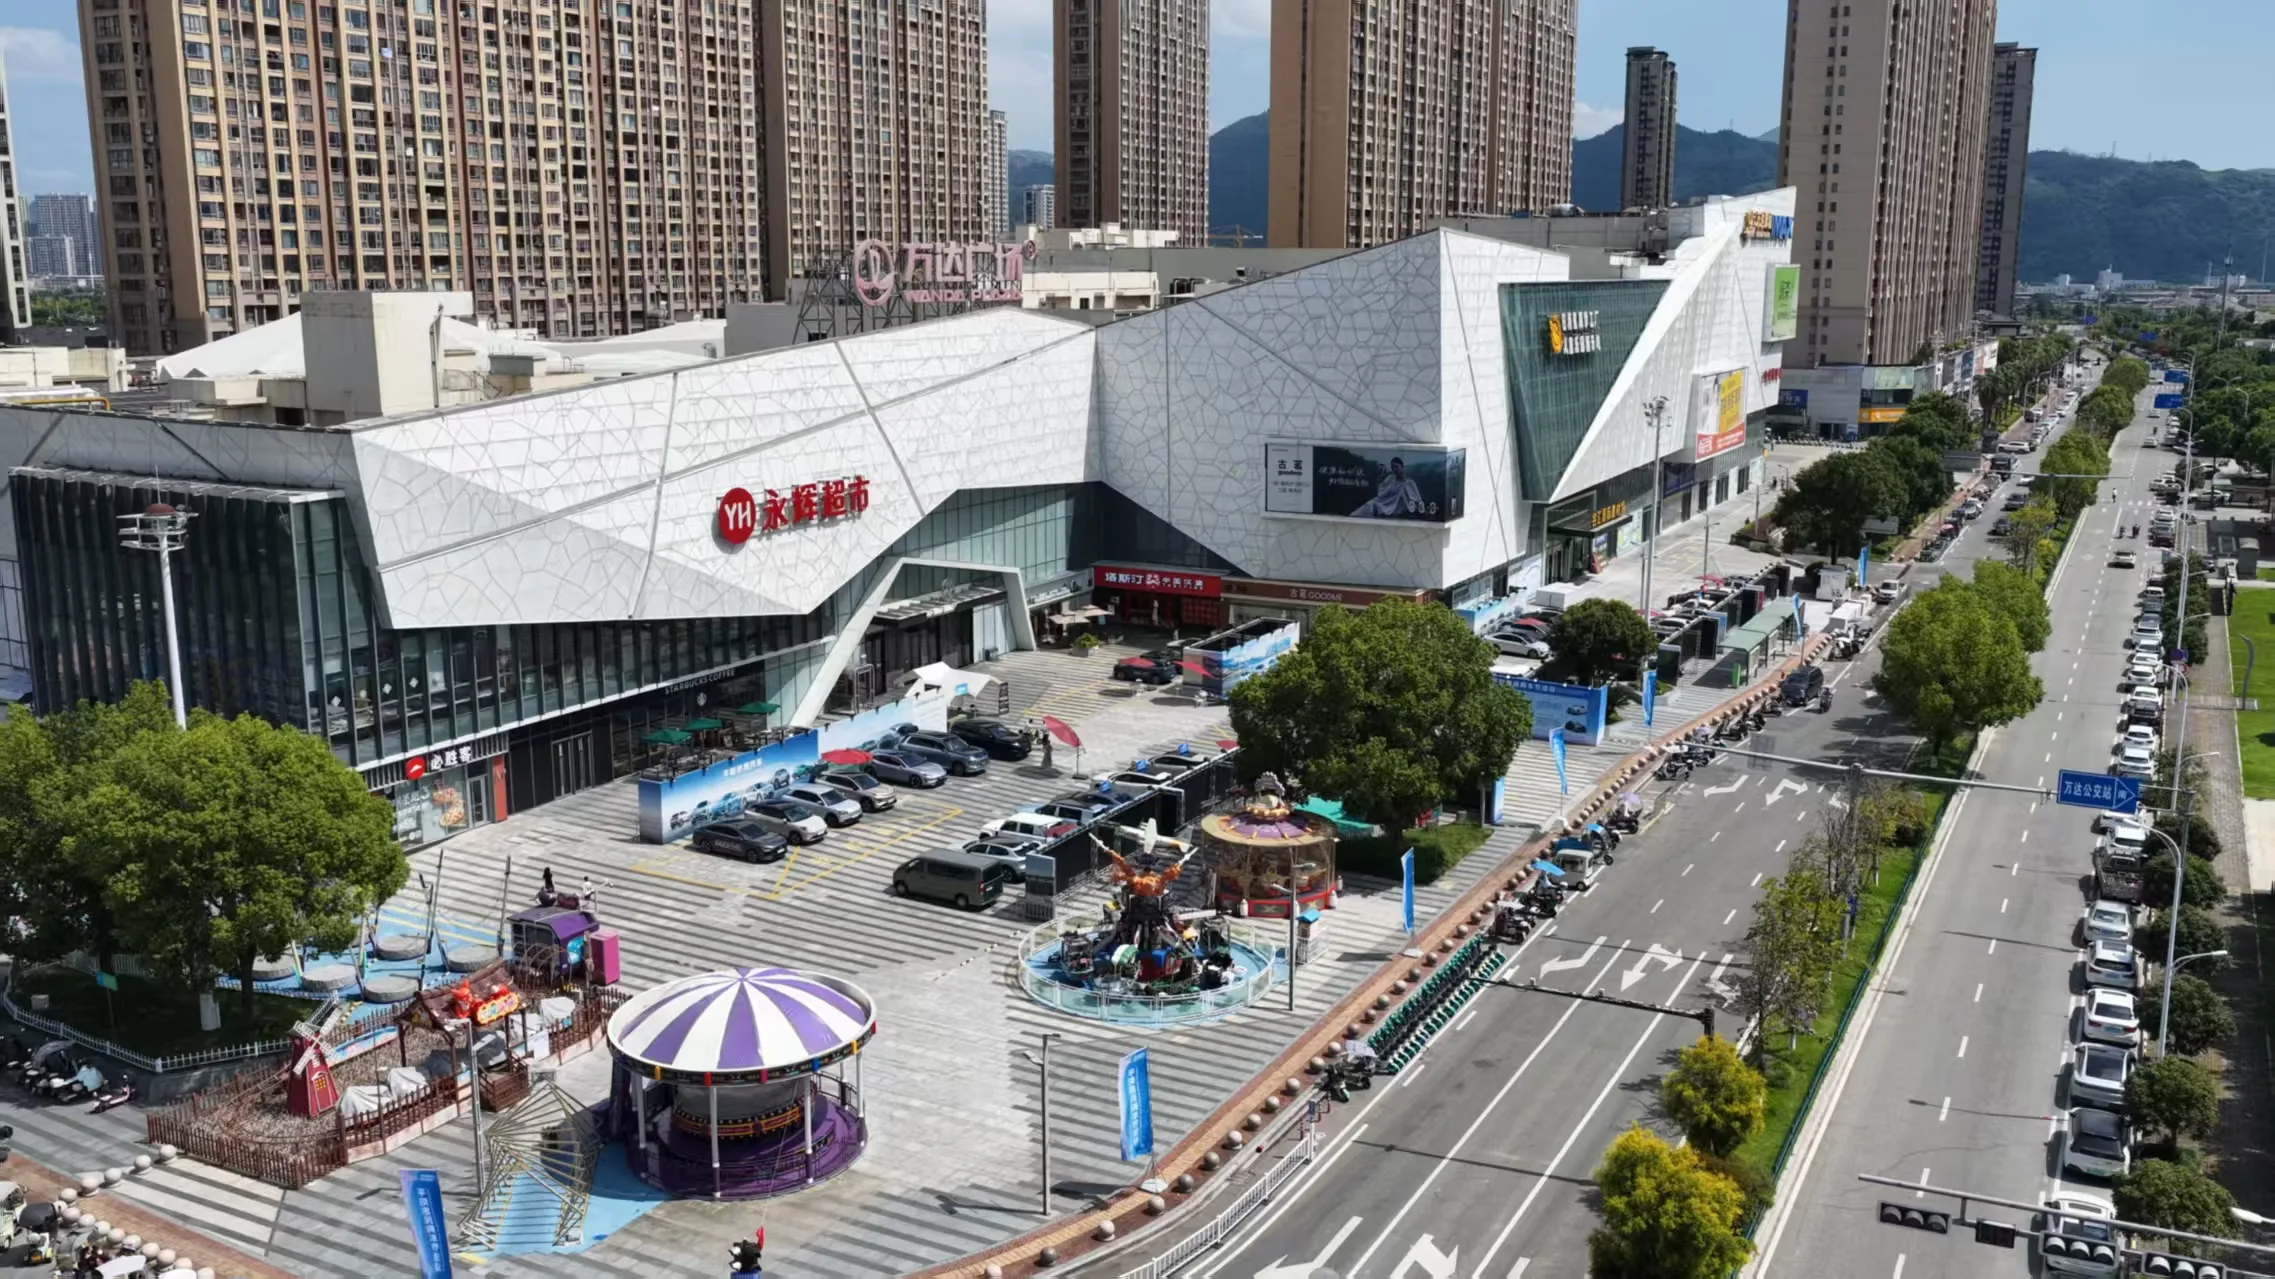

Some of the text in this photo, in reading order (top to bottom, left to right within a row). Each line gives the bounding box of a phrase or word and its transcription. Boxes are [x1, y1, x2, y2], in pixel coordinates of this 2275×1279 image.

[901, 240, 1023, 282] 万达广场
[903, 288, 1023, 303] WANDA PLAZA
[762, 474, 871, 531] 永辉超市
[724, 501, 752, 531] YH
[1105, 572, 1144, 585] 塔斯汀
[664, 669, 736, 695] STARBUCKS COFFEE
[430, 746, 472, 771] 必胜客
[2063, 781, 2113, 800] 万达公交站
